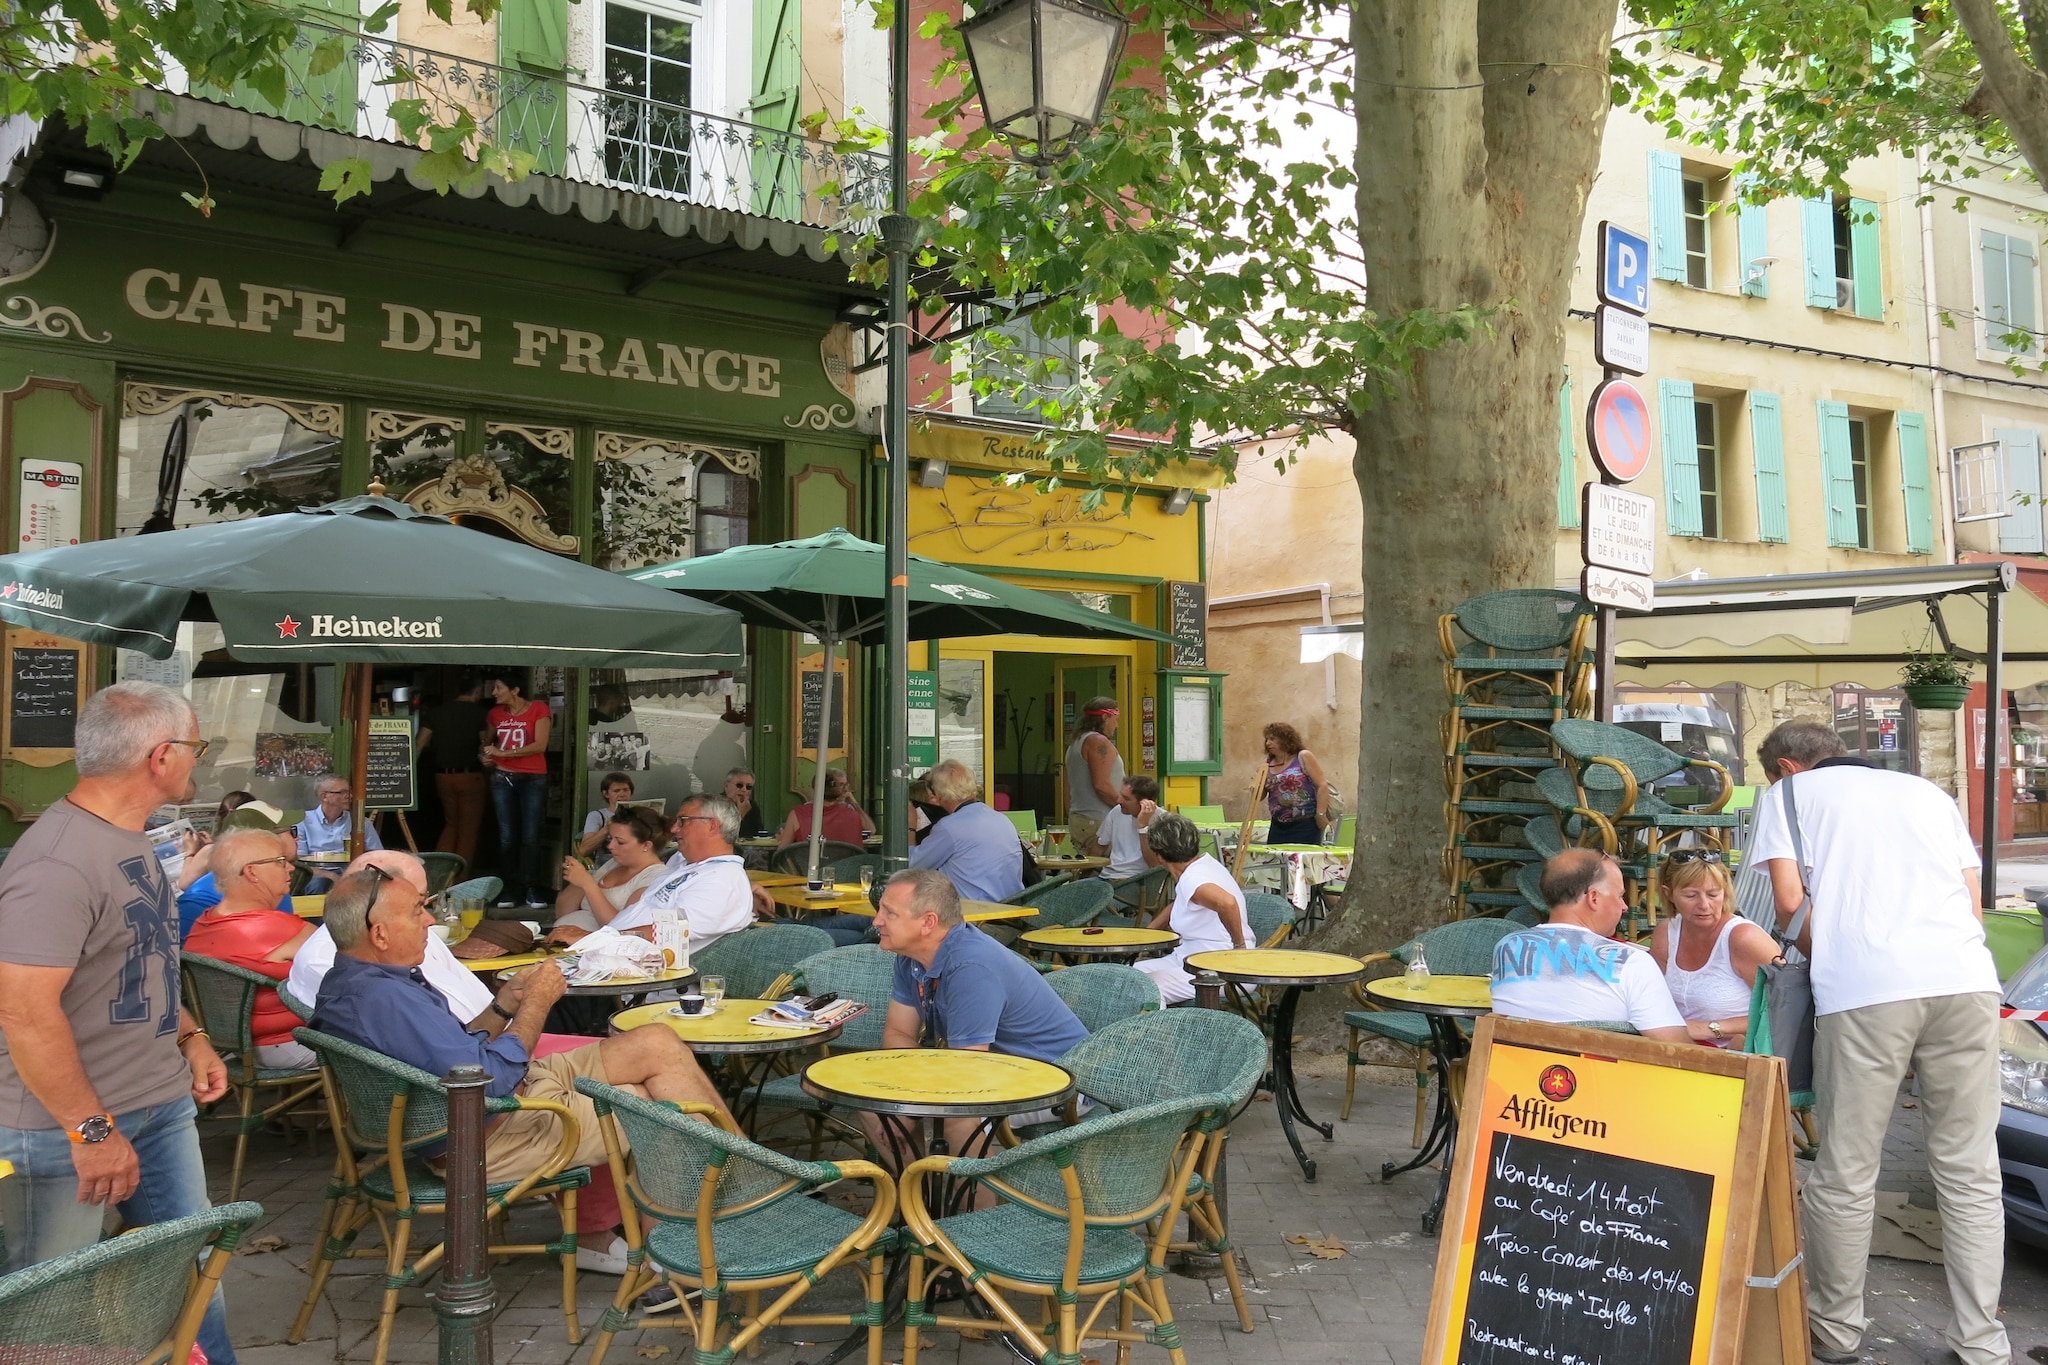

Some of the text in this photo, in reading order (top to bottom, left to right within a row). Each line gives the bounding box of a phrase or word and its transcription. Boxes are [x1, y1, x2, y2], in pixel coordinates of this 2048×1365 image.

[1617, 241, 1638, 289] P
[125, 267, 781, 398] CAFE DE FRANCE
[1606, 312, 1647, 334] STATIONNEMENT
[1616, 332, 1635, 346] PAYANT
[1609, 347, 1643, 365] HORODATEUR
[26, 472, 77, 484] MARTINI
[1599, 492, 1647, 519] INTERDIT
[1607, 515, 1640, 533] LE JEUDI
[1592, 527, 1652, 551] ET LE DIMANCHE
[1597, 544, 1607, 557] DE
[1610, 547, 1614, 558] 6
[1617, 548, 1621, 560] h
[1624, 550, 1629, 560] à
[1632, 552, 1639, 564] 15
[311, 615, 443, 638] Heineken
[496, 728, 526, 752] 79
[1497, 1094, 1608, 1139] Affligem
[1495, 1134, 1576, 1198] Vendredi
[1577, 1180, 1611, 1211] 14
[1494, 1195, 1522, 1211] au
[1579, 1213, 1607, 1237] de
[1605, 1221, 1671, 1250] France
[1479, 1264, 1510, 1288] avec
[1517, 1272, 1530, 1295] le
[1535, 1287, 1574, 1310] groupe
[1468, 1318, 1540, 1356] Restauration
[1543, 1343, 1556, 1360] et
